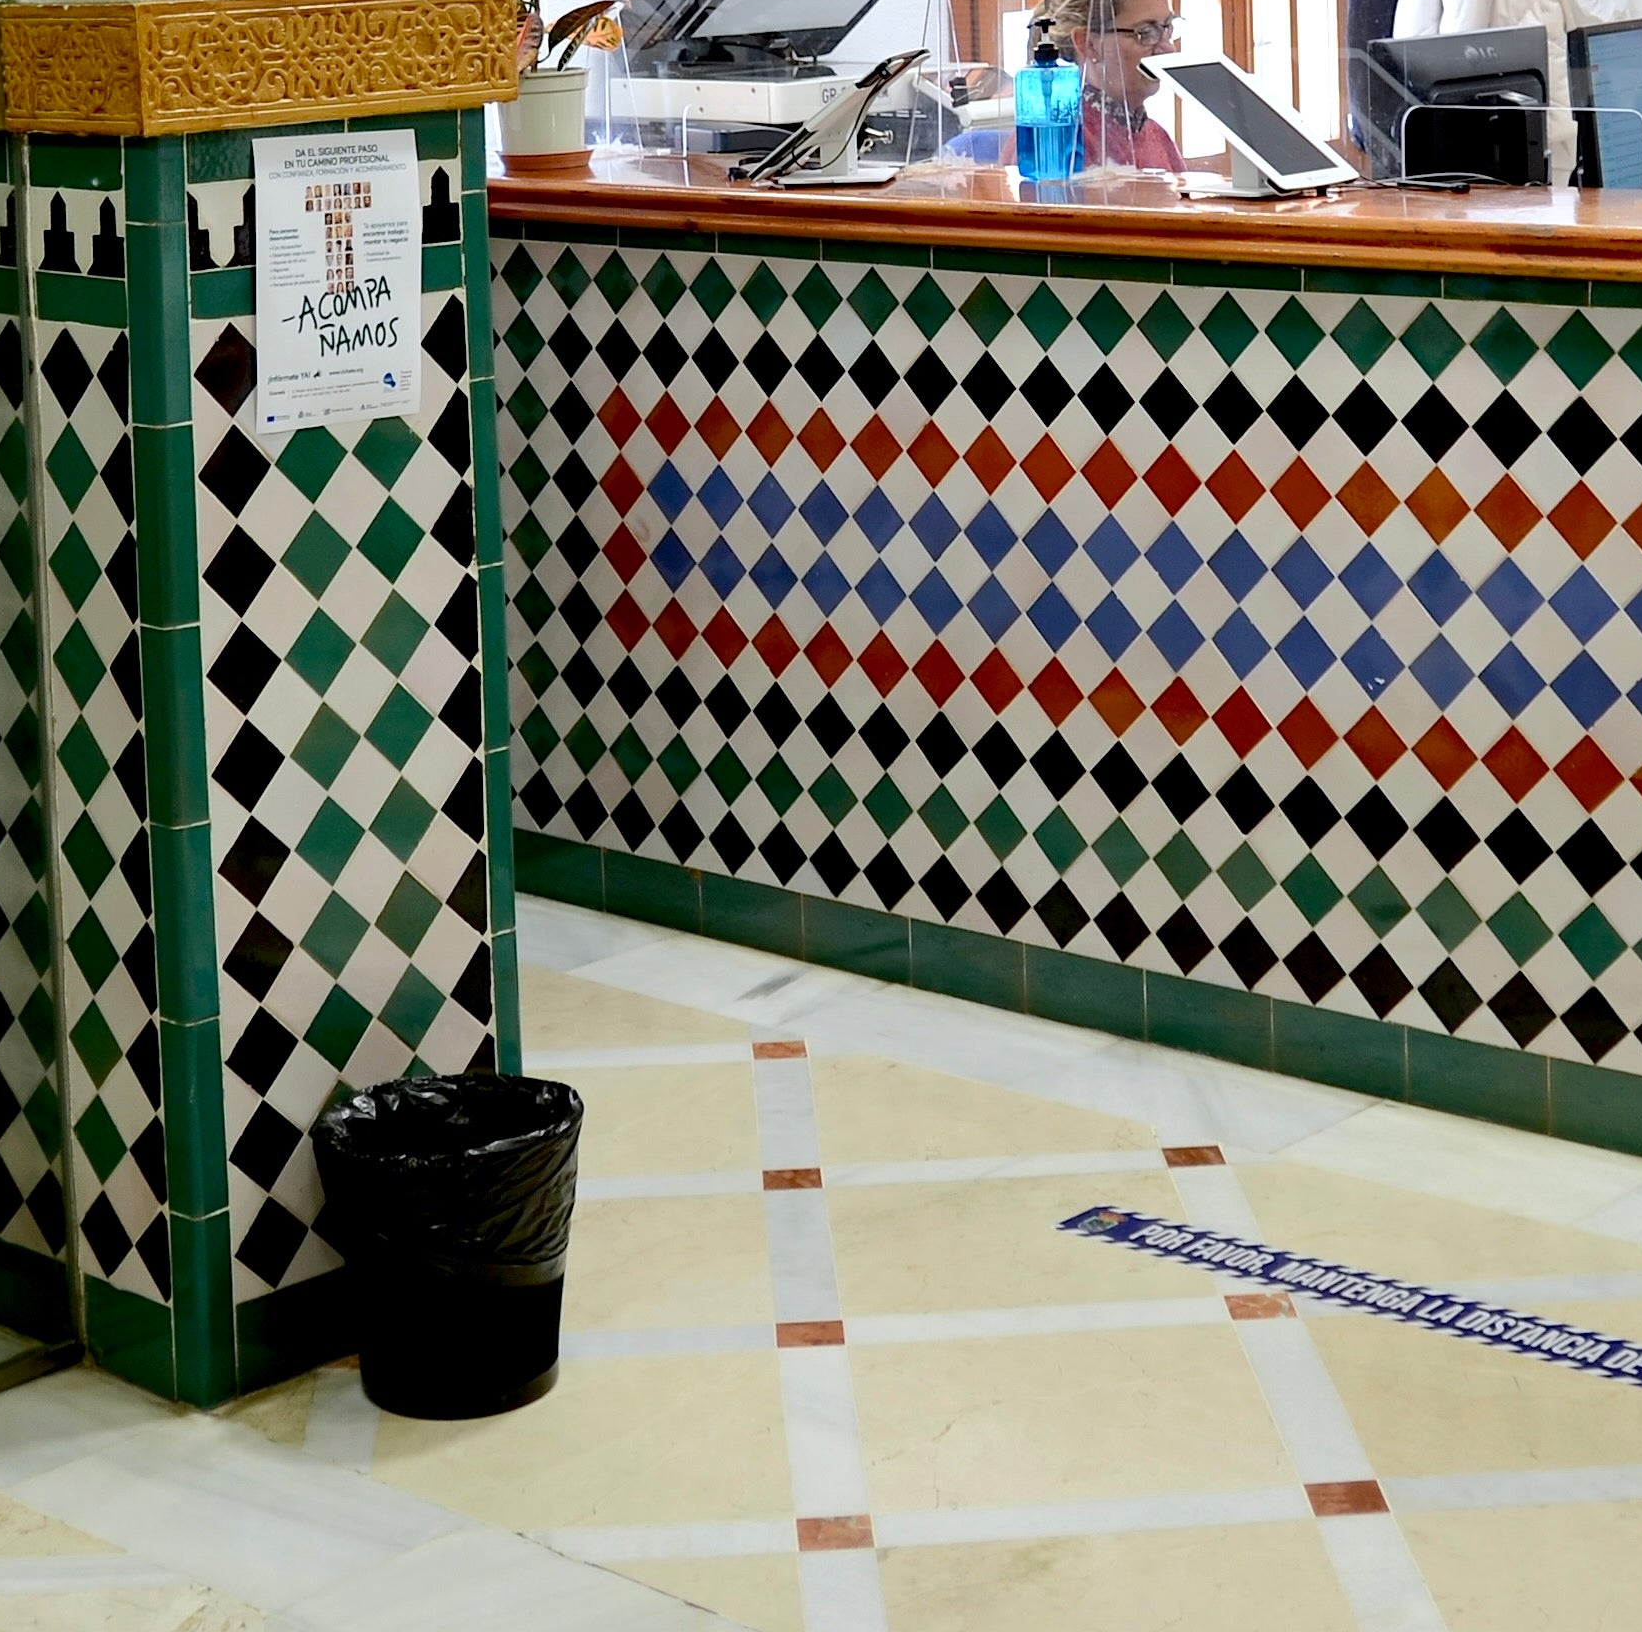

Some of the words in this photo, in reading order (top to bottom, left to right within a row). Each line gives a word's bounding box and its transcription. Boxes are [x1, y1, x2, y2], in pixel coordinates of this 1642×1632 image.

[295, 148, 306, 158] DA
[307, 147, 316, 157] EL
[317, 145, 356, 157] SIGUIENTE
[357, 144, 378, 153] PASO
[284, 160, 294, 169] EN
[296, 158, 306, 168] TU
[307, 156, 338, 168] CAMINO
[338, 154, 390, 165] PROFESIONAL
[268, 171, 282, 180] CON
[319, 316, 400, 358] ÑAMOS
[1128, 1223, 1187, 1252] POR
[1181, 1232, 1276, 1277] FAVOR,
[1269, 1260, 1425, 1314] MANTENGA
[1416, 1298, 1465, 1326] LA
[1454, 1309, 1610, 1366] DISTANCIA
